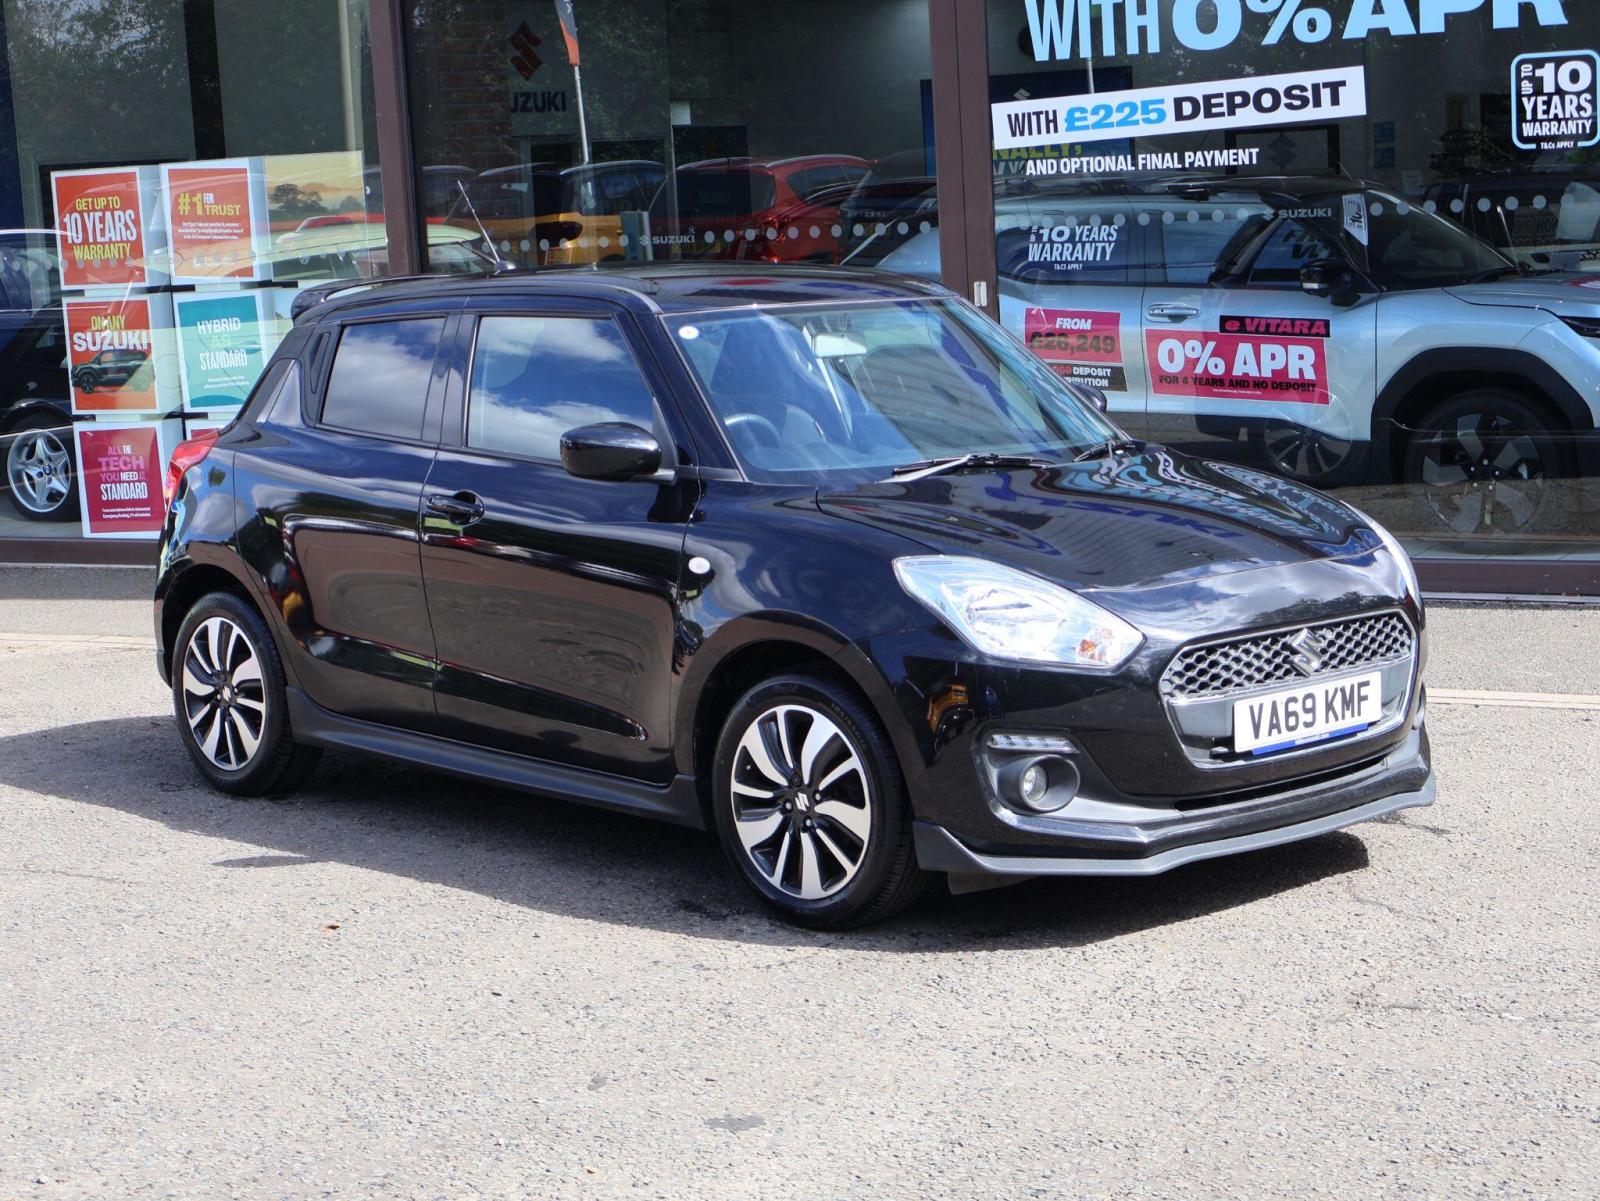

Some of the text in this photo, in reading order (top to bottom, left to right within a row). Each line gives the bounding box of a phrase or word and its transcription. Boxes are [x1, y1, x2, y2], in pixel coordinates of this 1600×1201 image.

[1024, 0, 1161, 62] WITH
[1521, 63, 1533, 94] UP TO
[1535, 60, 1592, 93] 10
[1007, 80, 1347, 137] WITH £225 DEPOSIT
[1521, 93, 1592, 120] YEARS
[1522, 119, 1592, 137] WARRANTY
[1556, 141, 1574, 149] APPLY
[1026, 158, 1057, 176] AND
[1060, 154, 1135, 174] OPTIONAL
[1138, 152, 1182, 170] FINAL
[1184, 148, 1259, 169] PAYMENT
[75, 196, 120, 210] GET UP TO
[178, 192, 203, 216] #1
[204, 204, 241, 216] TRUST
[1278, 207, 1332, 219] SUZUKI
[64, 209, 137, 244] 10 YEARS
[1039, 225, 1118, 242] 10 YEARS
[652, 234, 695, 245] SUZUKI
[73, 243, 131, 261] WARRANTY
[1028, 242, 1115, 262] WARRANTY
[91, 314, 125, 330] ON ANY
[197, 317, 241, 335] HYBRID
[1055, 318, 1092, 330] FROM
[1244, 318, 1326, 334] VITARA
[73, 330, 148, 352] SUZUKI
[211, 334, 231, 349] AS
[1030, 332, 1116, 354] £26,249
[199, 349, 248, 370] STANDARD
[1157, 338, 1316, 380] 0% APR
[1073, 367, 1111, 376] DEPOSIT
[1159, 375, 1179, 384] FOR
[1191, 376, 1226, 387] YEARS
[1228, 378, 1250, 388] AND
[1253, 380, 1268, 390] NO
[1271, 381, 1317, 392] DEPOSIT
[108, 446, 122, 455] ALL
[98, 456, 145, 471] TECH
[101, 472, 119, 482] YOU
[120, 471, 139, 481] NEED
[100, 482, 148, 500] STANDARD
[1249, 680, 1371, 740] VA69 KMF
